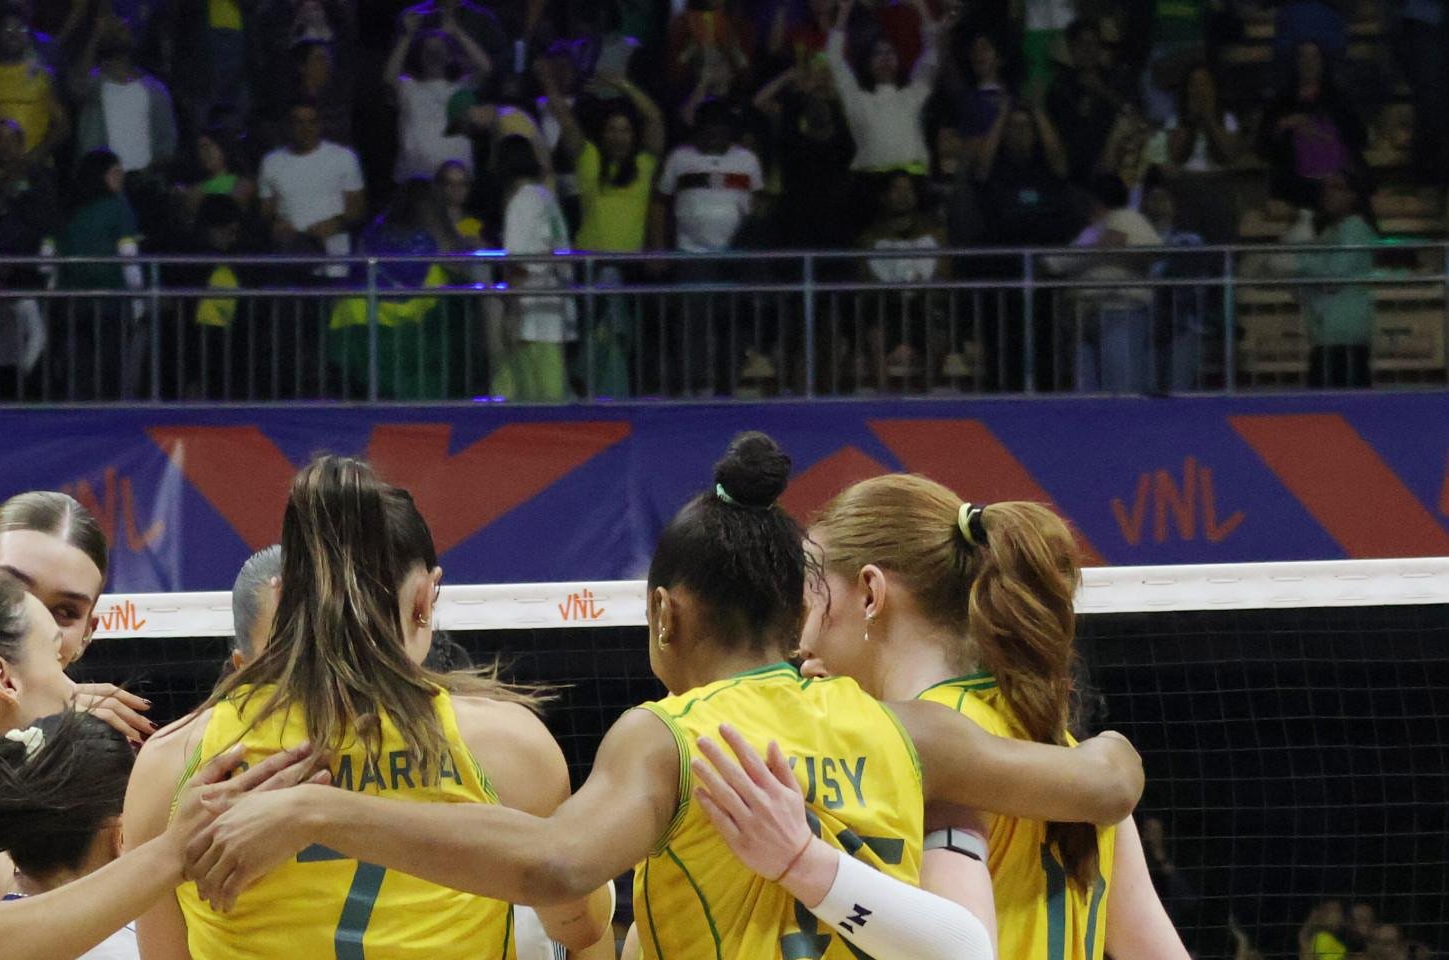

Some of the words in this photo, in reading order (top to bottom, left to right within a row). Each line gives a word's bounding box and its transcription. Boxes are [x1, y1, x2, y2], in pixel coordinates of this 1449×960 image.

[61, 467, 166, 552] NL
[1113, 457, 1243, 544] VNL
[101, 600, 146, 631] VNL
[558, 588, 605, 621] VNL
